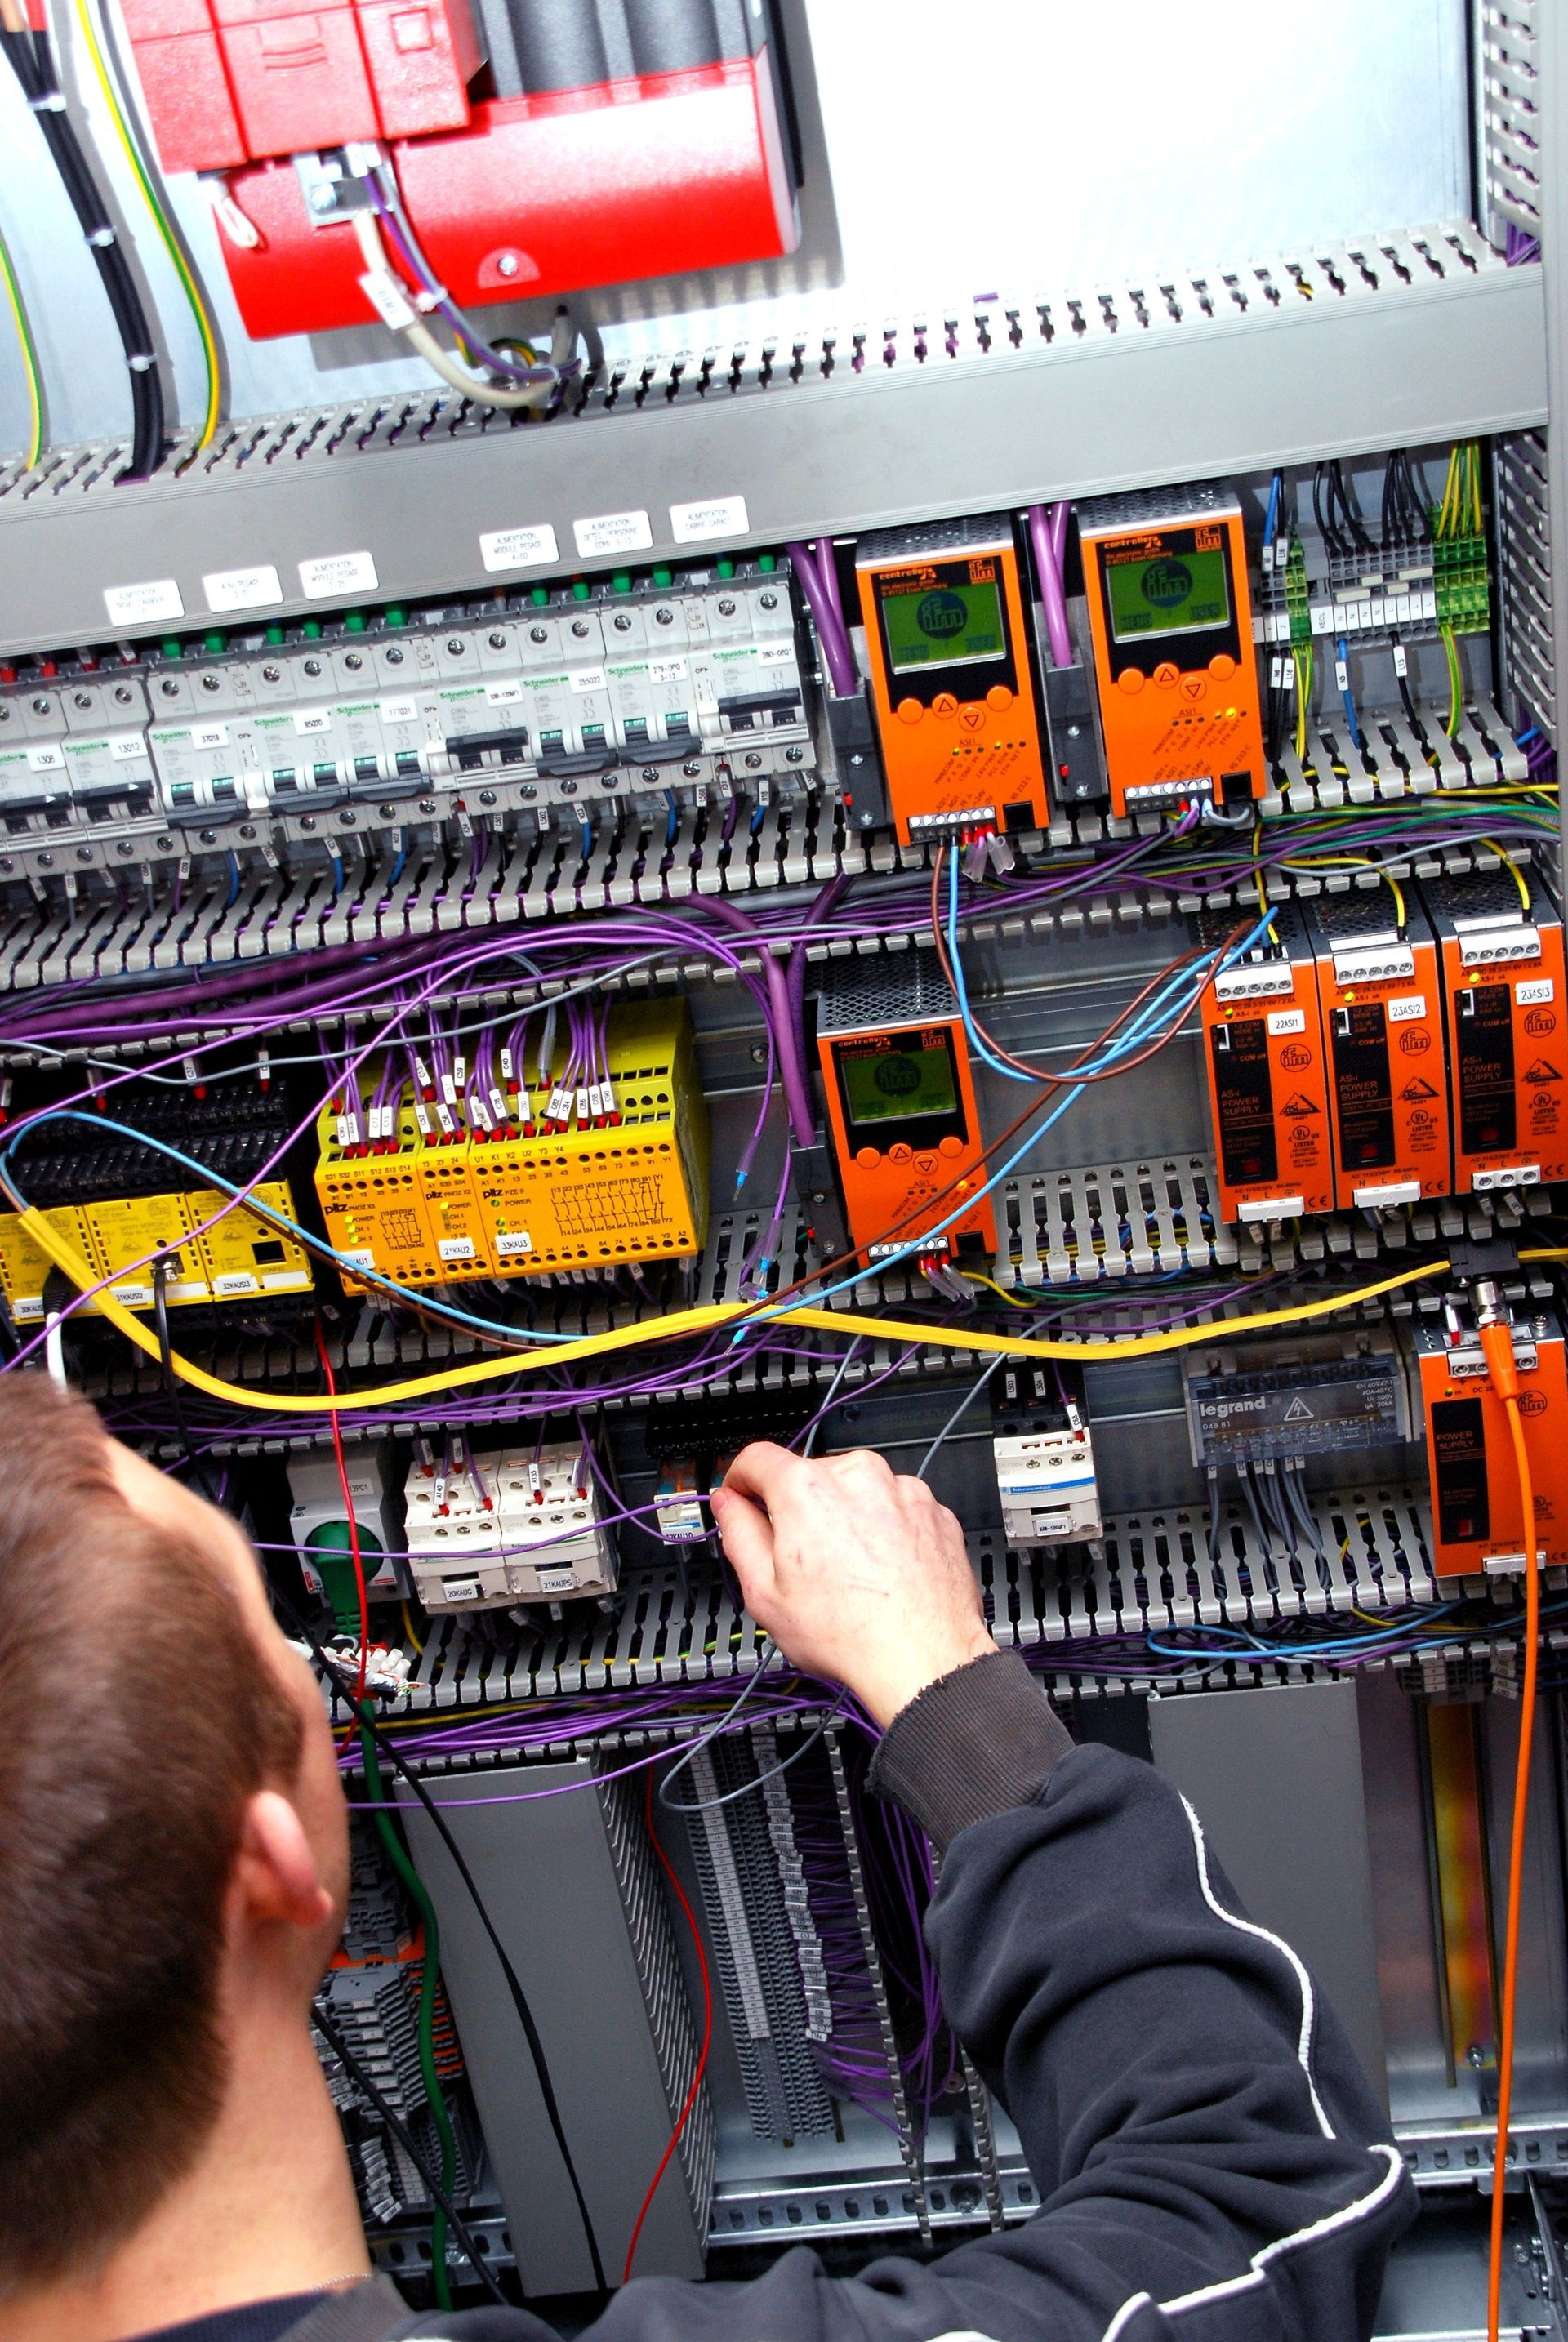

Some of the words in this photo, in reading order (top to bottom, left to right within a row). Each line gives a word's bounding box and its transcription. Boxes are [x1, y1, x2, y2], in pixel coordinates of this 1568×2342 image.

[712, 648, 749, 663] Schneider
[607, 665, 646, 679] Schneider
[523, 677, 559, 691] Schneider
[439, 689, 476, 703] Schneider
[336, 705, 373, 718] Schneider
[254, 715, 292, 729] Schneider
[152, 732, 189, 745] Schneider
[65, 742, 103, 757] Schneider
[1463, 1062, 1501, 1075] POWER
[1463, 1071, 1502, 1084] SUPPLY
[1339, 1080, 1378, 1093] POWER
[1222, 1096, 1259, 1108] POWER
[1340, 1090, 1379, 1102] SUPPLY
[1223, 1105, 1260, 1117] SUPPLY
[353, 1169, 365, 1178] S11
[370, 1168, 382, 1176] S12
[385, 1166, 397, 1174] S13
[399, 1164, 411, 1173] S14
[425, 1191, 443, 1201] pilz
[483, 1188, 504, 1200] pilz
[323, 1202, 349, 1216] pilz
[447, 1201, 472, 1210] POWER
[504, 1198, 531, 1207] POWER
[501, 1240, 528, 1251] 33KAU3
[1007, 1379, 1015, 1394] L503
[1376, 1400, 1394, 1408] 20kA
[1377, 1393, 1394, 1402] 500V
[1520, 1394, 1546, 1413] ifm
[1200, 1396, 1267, 1418] legrand
[1202, 1422, 1219, 1431] 048
[1220, 1420, 1232, 1428] 81
[1437, 1431, 1473, 1441] POWER
[1438, 1439, 1475, 1450] SUPPLY
